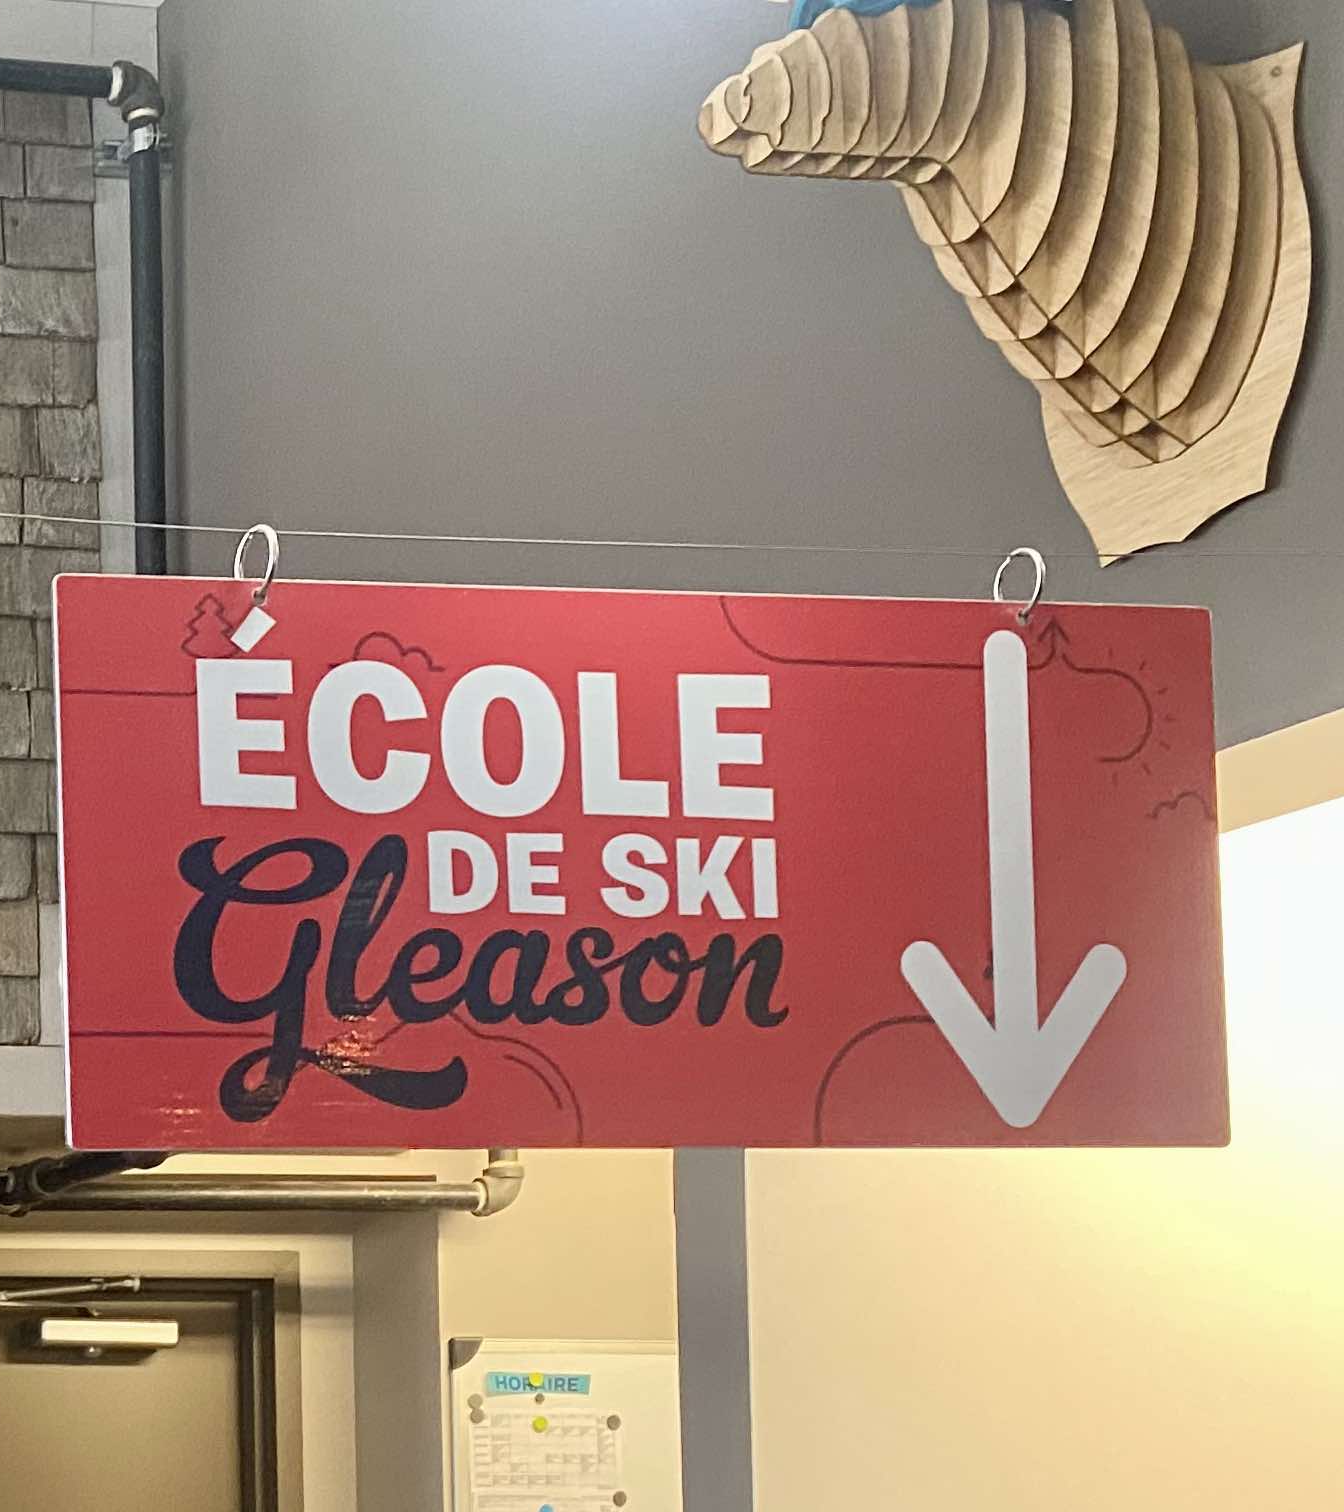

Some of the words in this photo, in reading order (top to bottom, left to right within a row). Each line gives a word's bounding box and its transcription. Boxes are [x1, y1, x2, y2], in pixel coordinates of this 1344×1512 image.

[196, 605, 775, 821] ÉCOLE
[427, 830, 563, 915] DE
[601, 834, 779, 919] SKI
[173, 834, 790, 1124] Gleason
[495, 1375, 580, 1392] HORIRE
